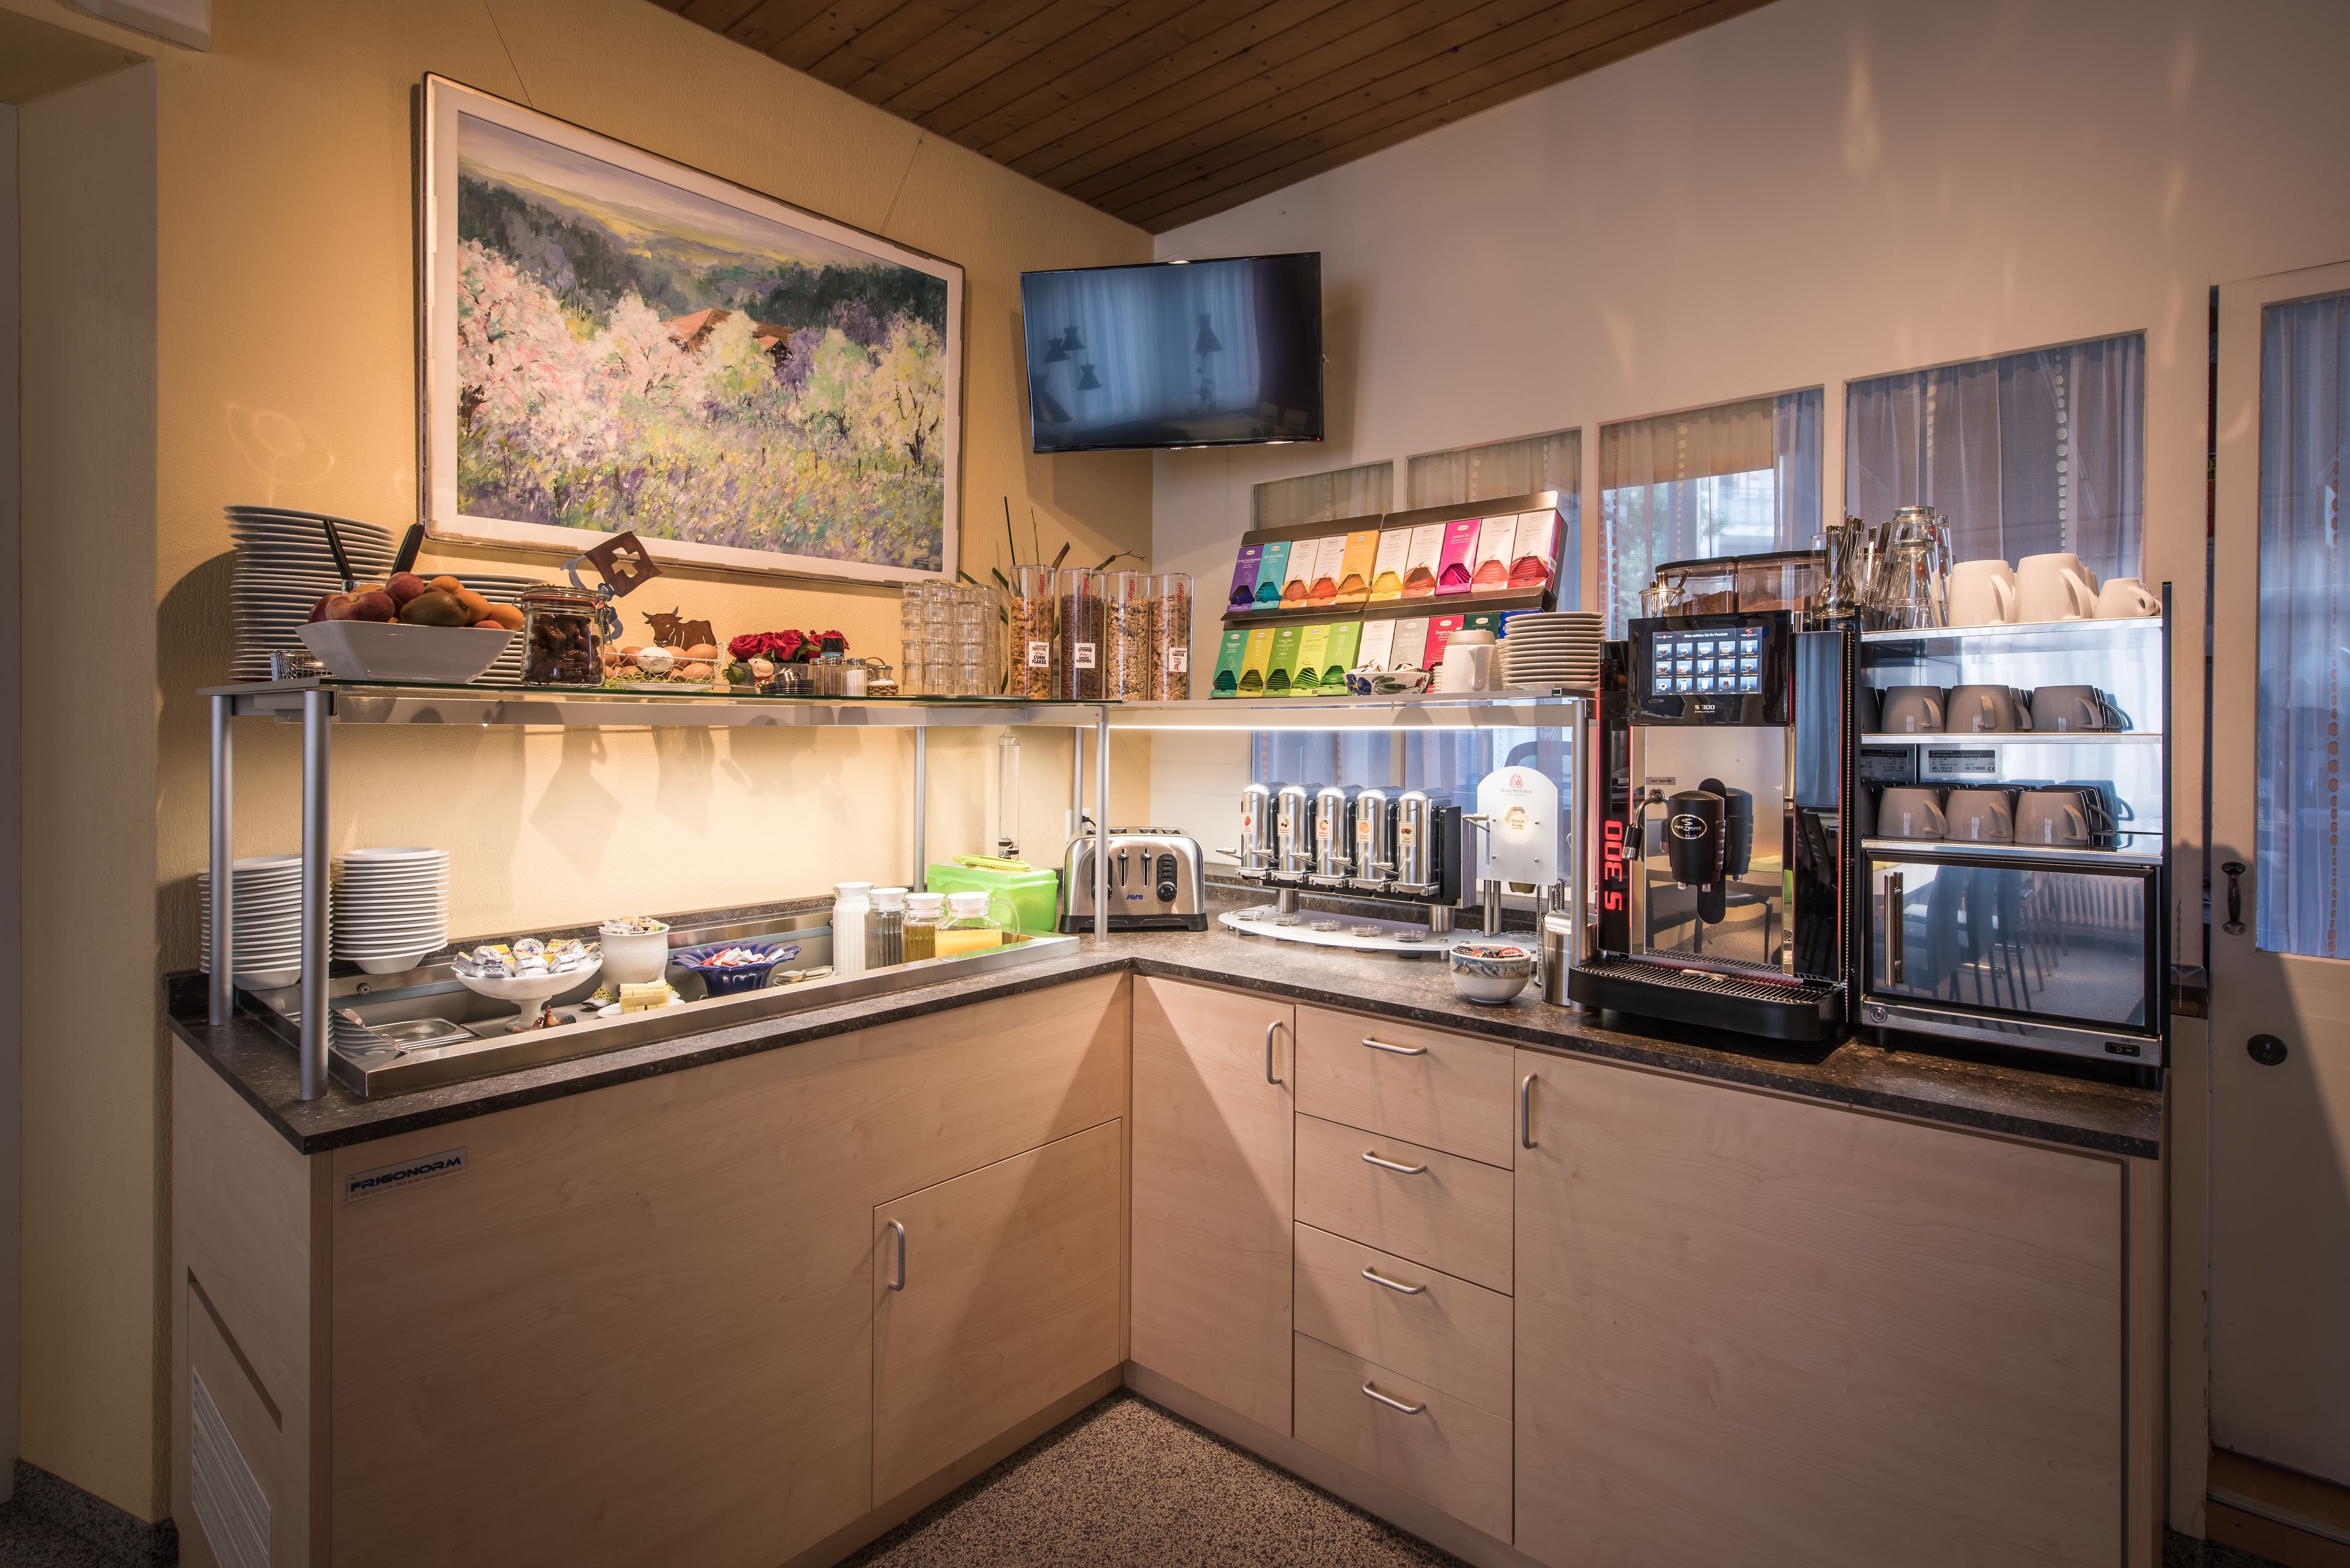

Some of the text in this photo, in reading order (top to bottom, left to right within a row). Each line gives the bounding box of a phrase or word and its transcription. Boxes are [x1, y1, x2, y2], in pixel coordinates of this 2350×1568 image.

[1605, 820, 1622, 911] S 300
[350, 1157, 461, 1192] FRIGONORM
[424, 1167, 462, 1181] www.frigonorm.ch
